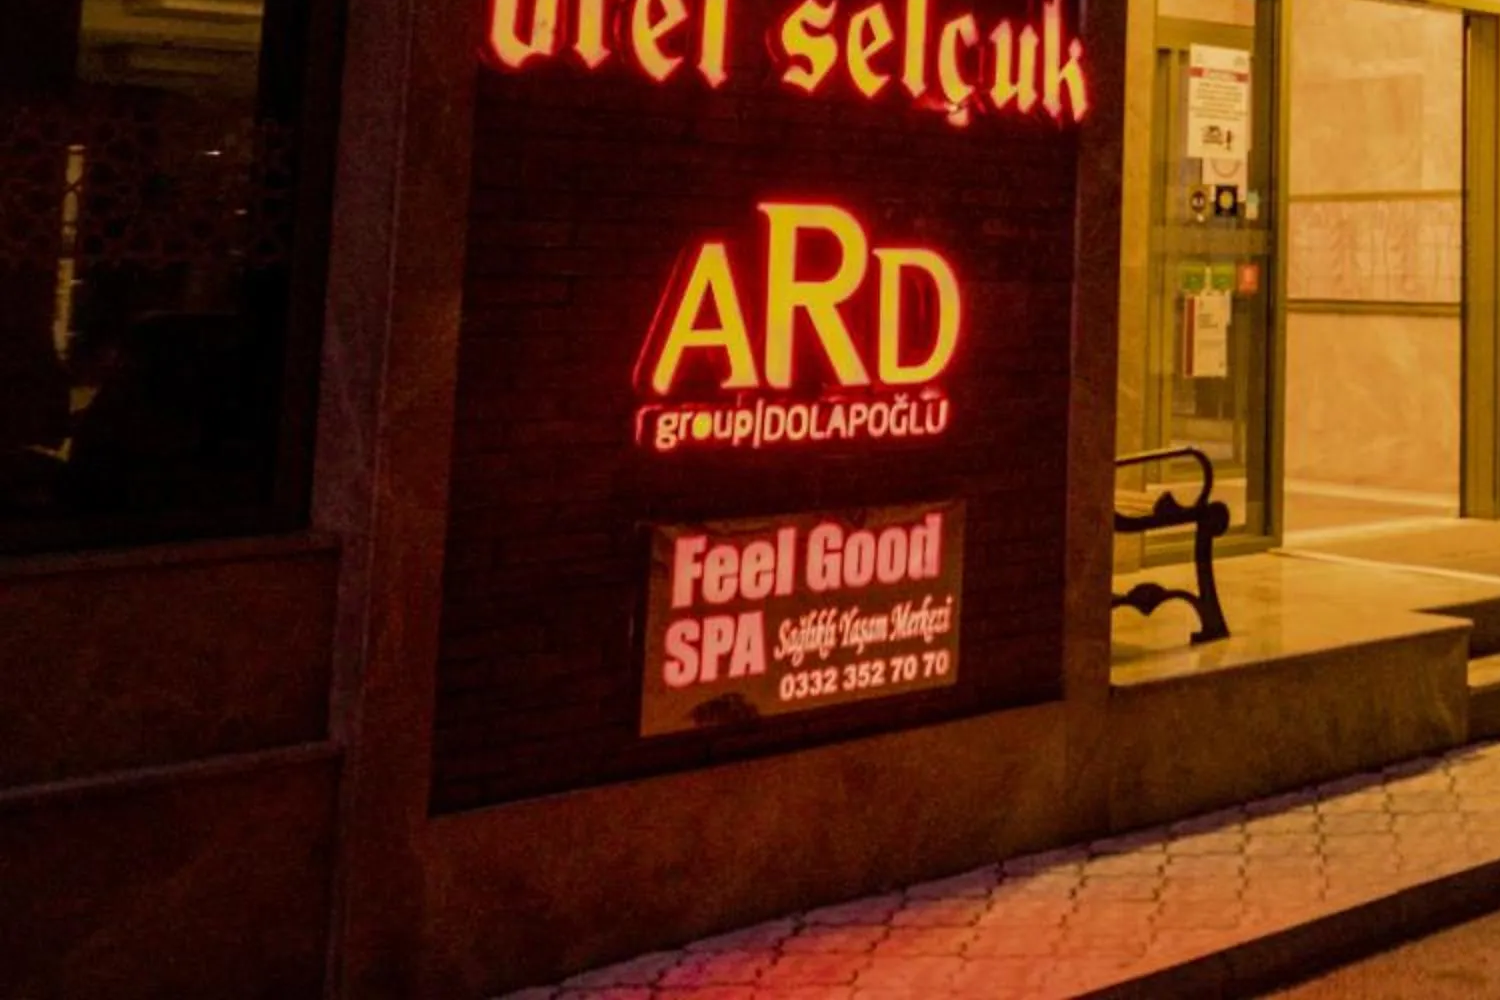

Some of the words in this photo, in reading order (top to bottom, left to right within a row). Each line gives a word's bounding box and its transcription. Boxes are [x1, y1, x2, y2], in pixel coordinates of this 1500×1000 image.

[651, 202, 962, 396] ARD
[671, 526, 798, 609] Feel
[805, 513, 944, 592] Good
[663, 610, 767, 688] SPA
[779, 667, 838, 701] 0332
[842, 658, 886, 692] 352
[890, 653, 918, 683] 70
[922, 650, 949, 679] 70
